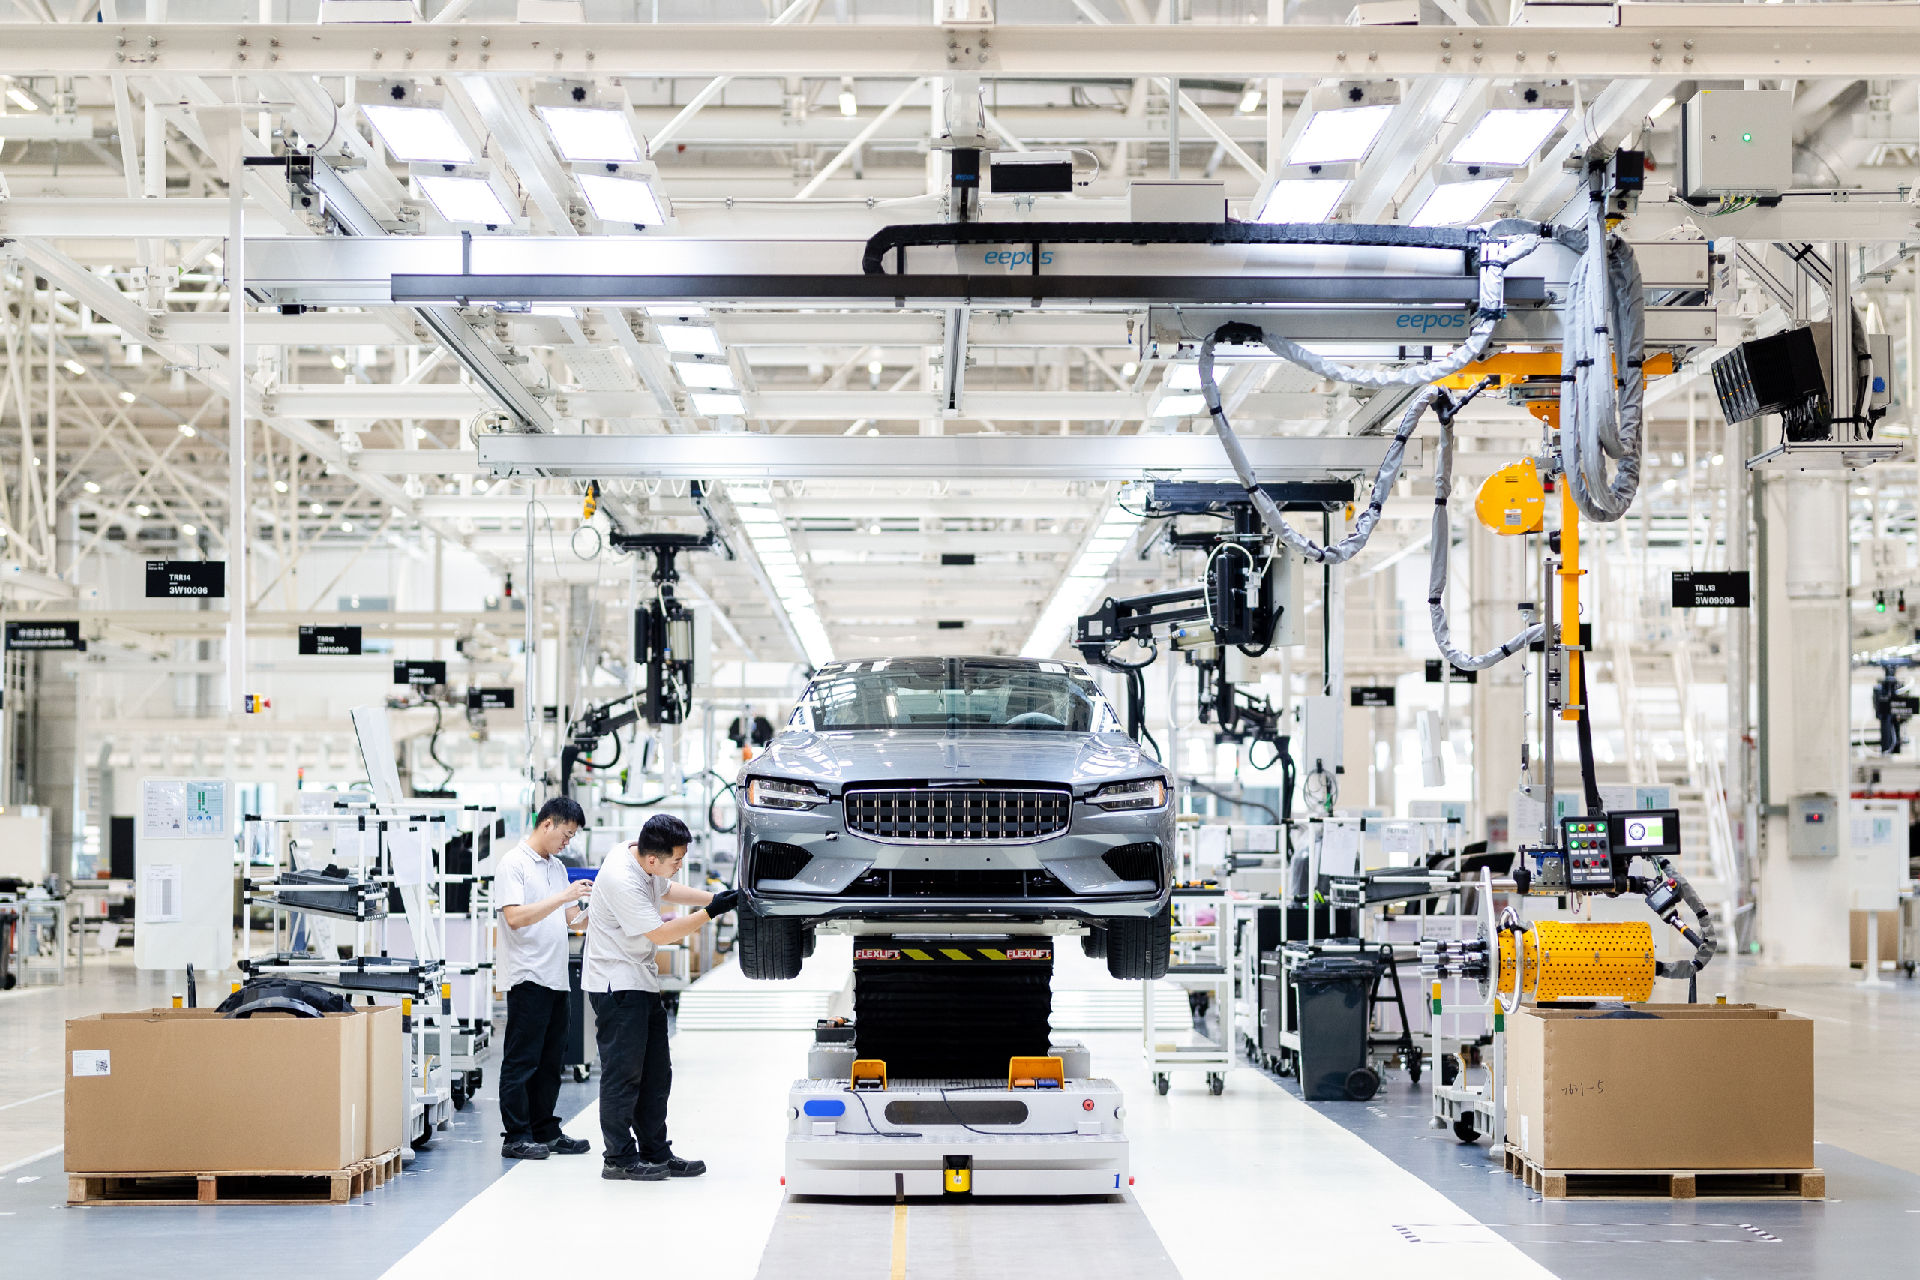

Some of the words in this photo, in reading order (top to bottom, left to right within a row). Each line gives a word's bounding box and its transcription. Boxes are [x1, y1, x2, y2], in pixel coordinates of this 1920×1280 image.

[1396, 314, 1466, 334] eepos
[855, 949, 900, 958] FLEXLIFT
[1006, 949, 1051, 958] FLEXLIFT
[1112, 1173, 1121, 1189] 1
